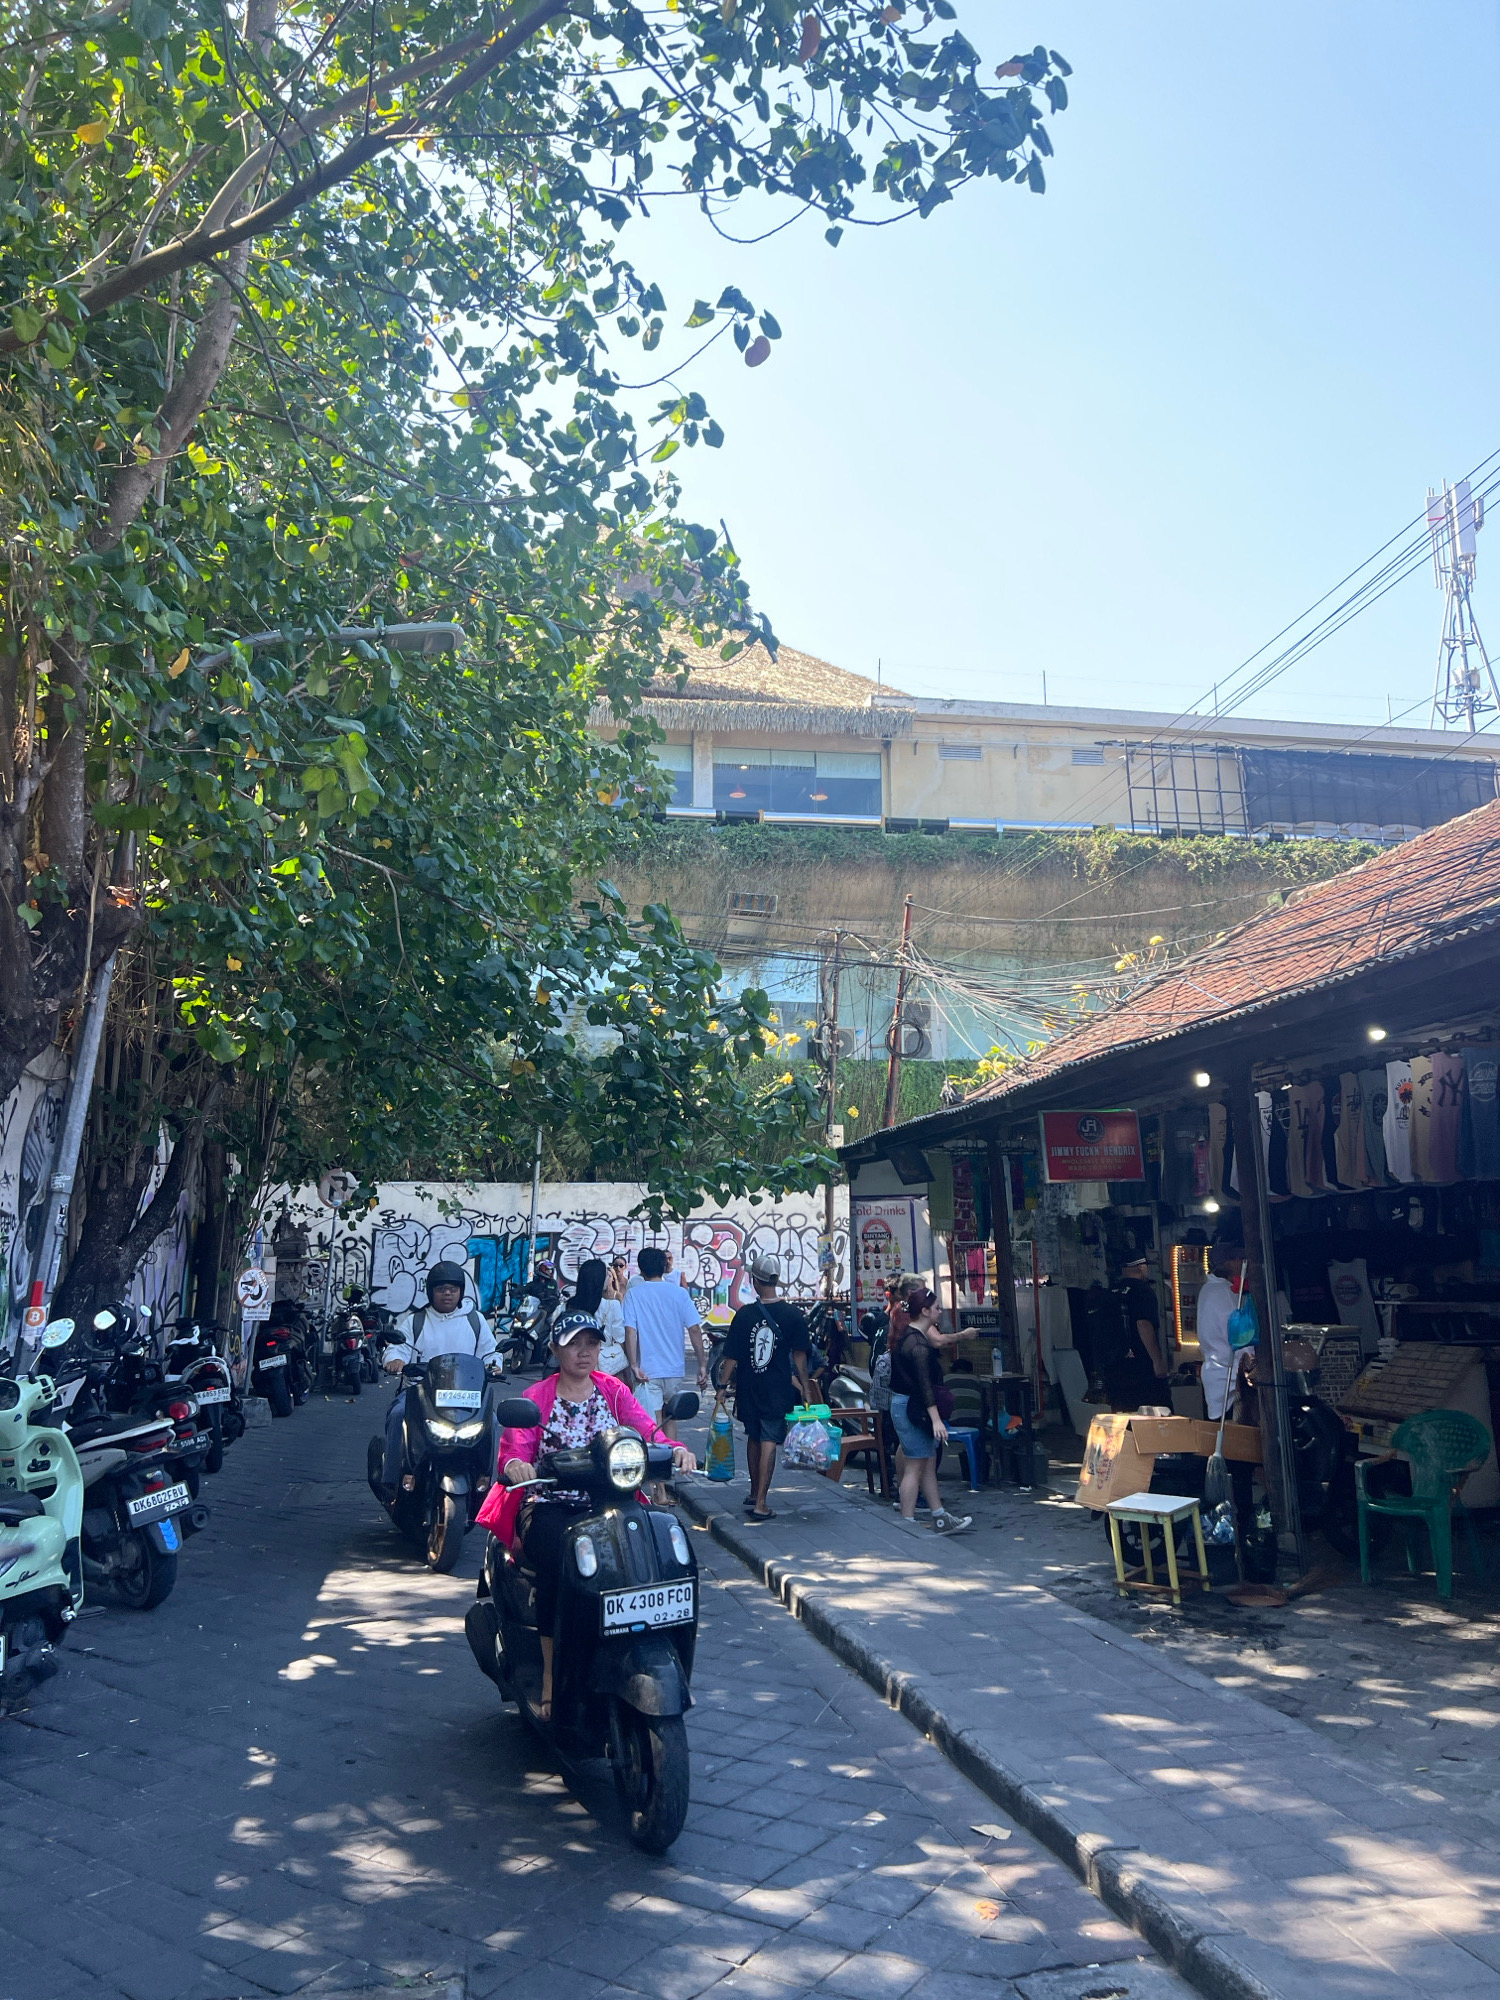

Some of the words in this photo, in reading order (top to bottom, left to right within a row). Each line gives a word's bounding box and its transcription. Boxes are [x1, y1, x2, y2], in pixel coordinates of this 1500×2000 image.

[1051, 1146, 1074, 1157] JIMMY
[1103, 1145, 1136, 1156] HENDRIX
[875, 1205, 906, 1216] Drinks
[606, 1597, 625, 1615] DK
[629, 1592, 664, 1611] 4308
